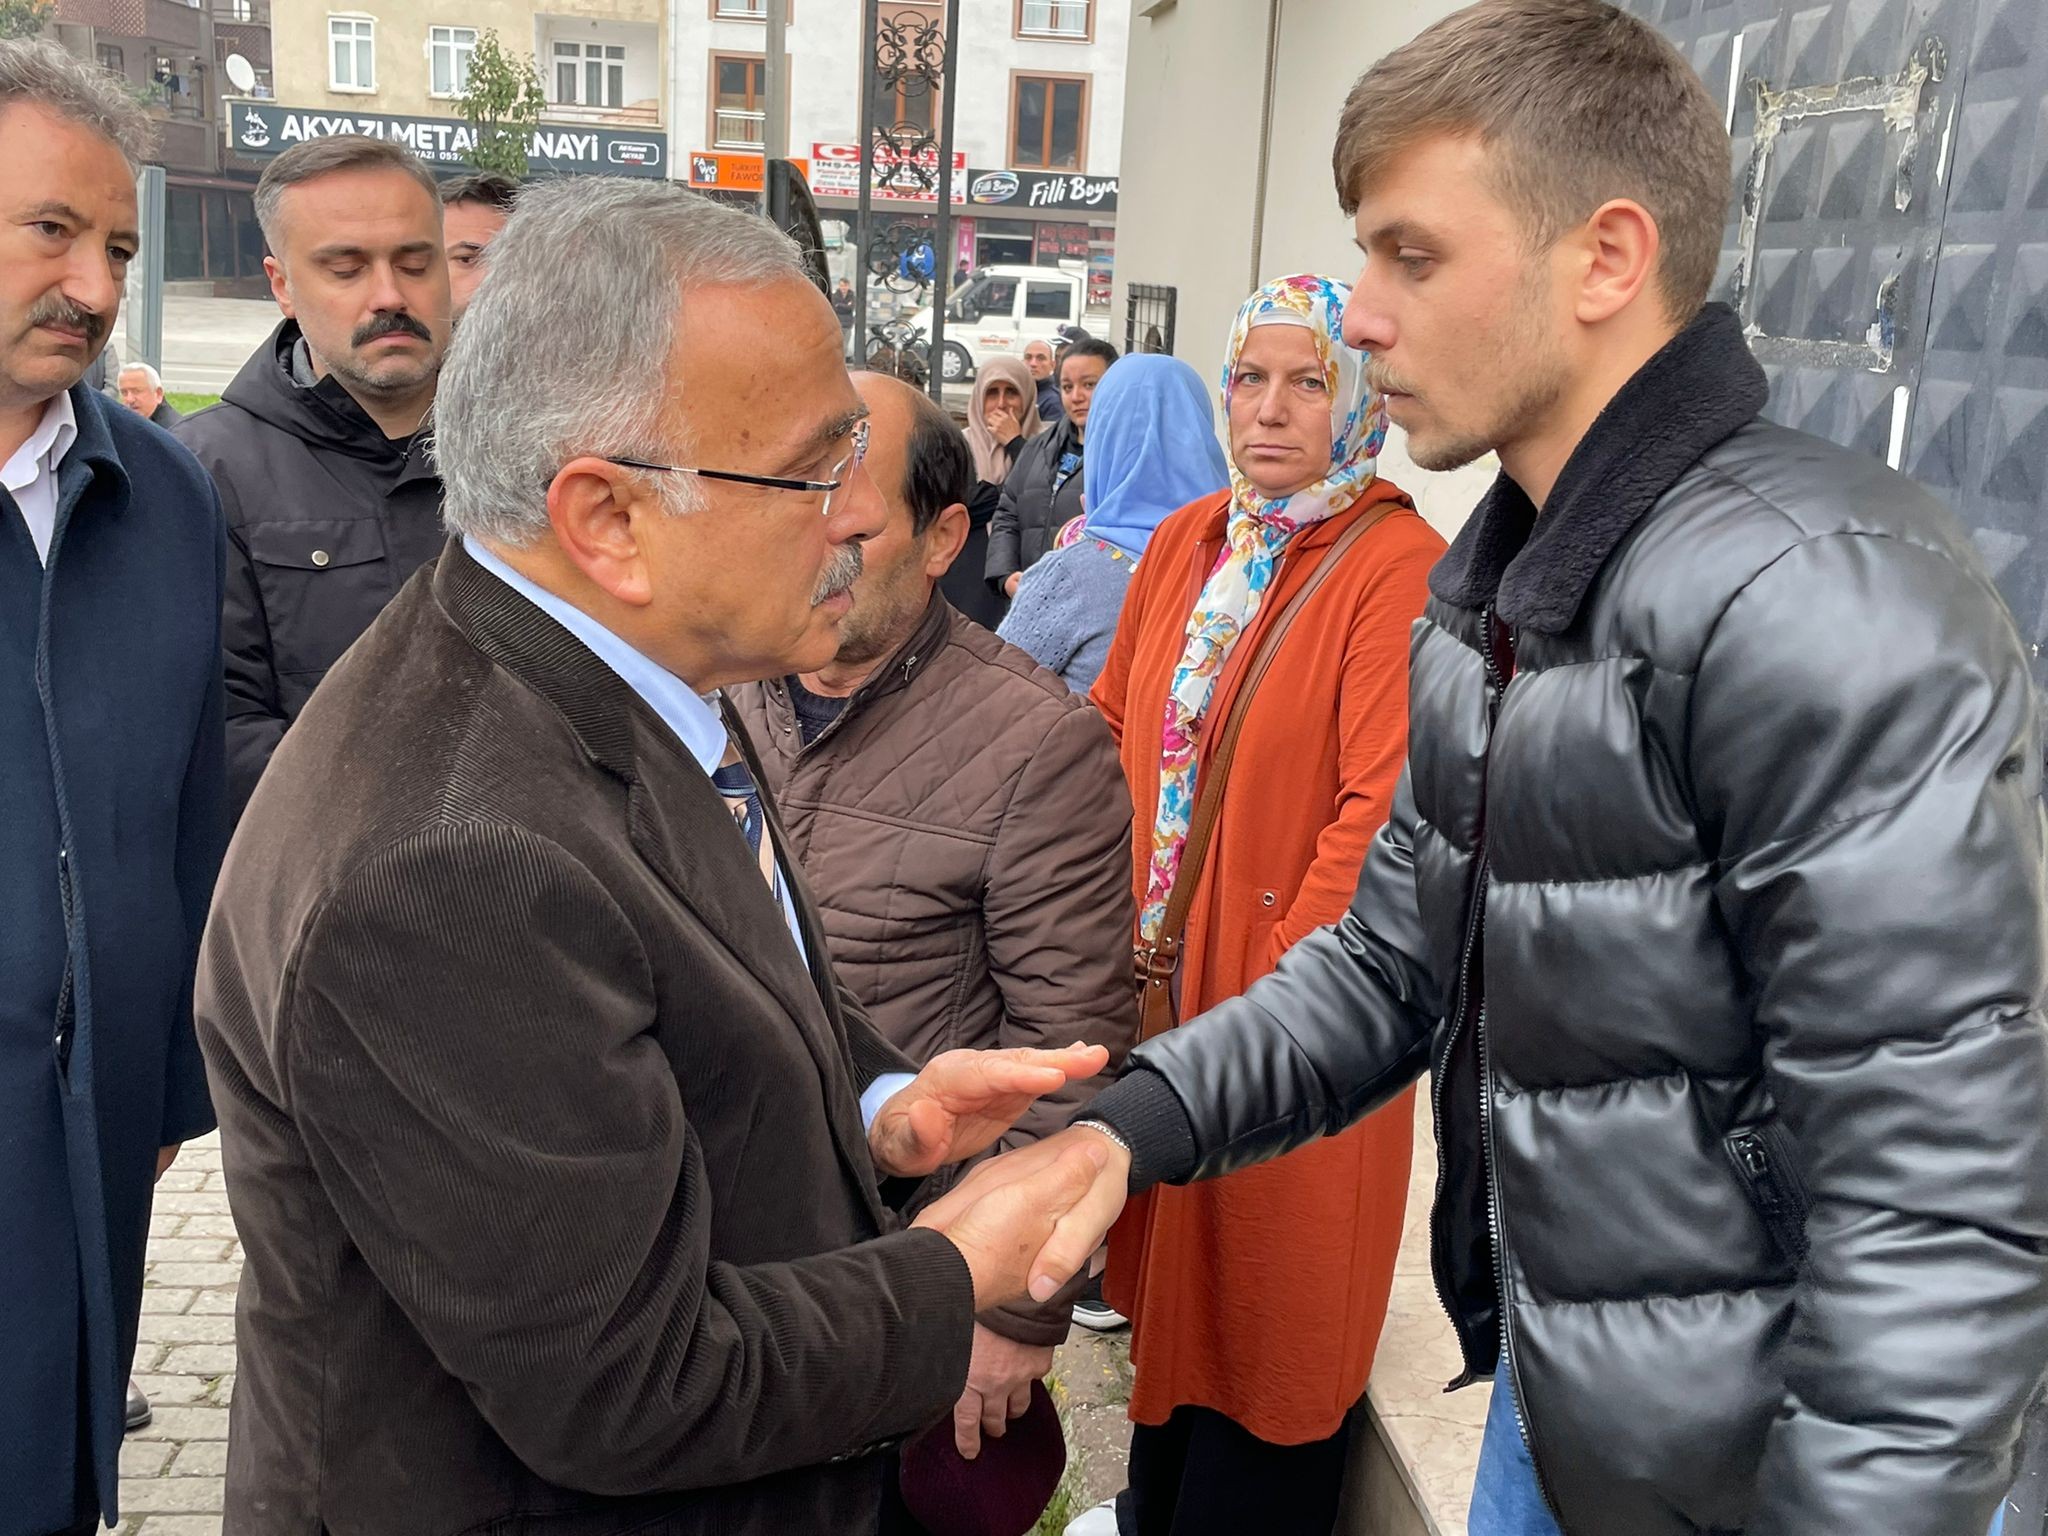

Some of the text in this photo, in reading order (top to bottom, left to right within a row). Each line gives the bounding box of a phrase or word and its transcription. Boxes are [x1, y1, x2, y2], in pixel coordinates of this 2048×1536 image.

[280, 114, 384, 142] AKYAZI
[1029, 175, 1119, 207] Filli Boya
